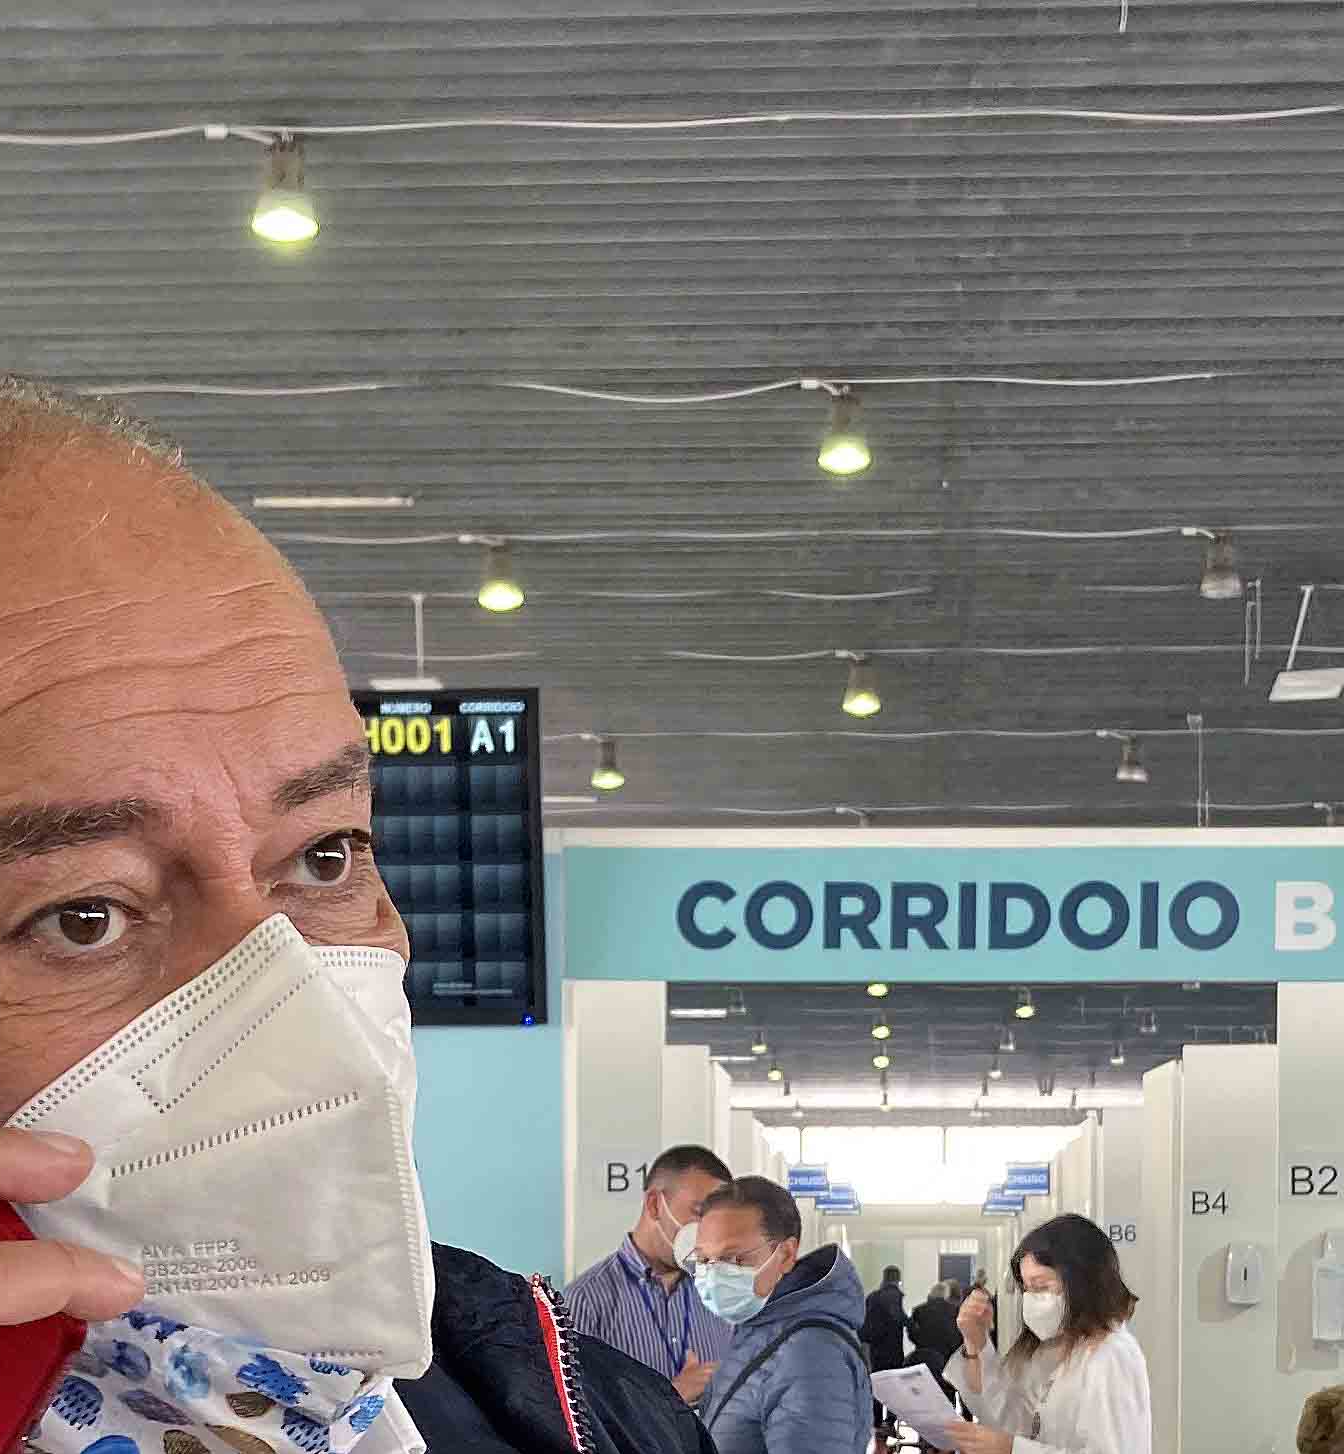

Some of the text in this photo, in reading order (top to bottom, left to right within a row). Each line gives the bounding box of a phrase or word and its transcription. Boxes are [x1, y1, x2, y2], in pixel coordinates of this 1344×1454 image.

[470, 718, 515, 753] A1
[676, 880, 1337, 952] CORRIDOIO B
[607, 1163, 649, 1192] B1
[1290, 1165, 1338, 1195] B2
[1191, 1191, 1229, 1215] B4
[192, 1240, 240, 1256] FFP3
[1109, 1225, 1136, 1242] B6
